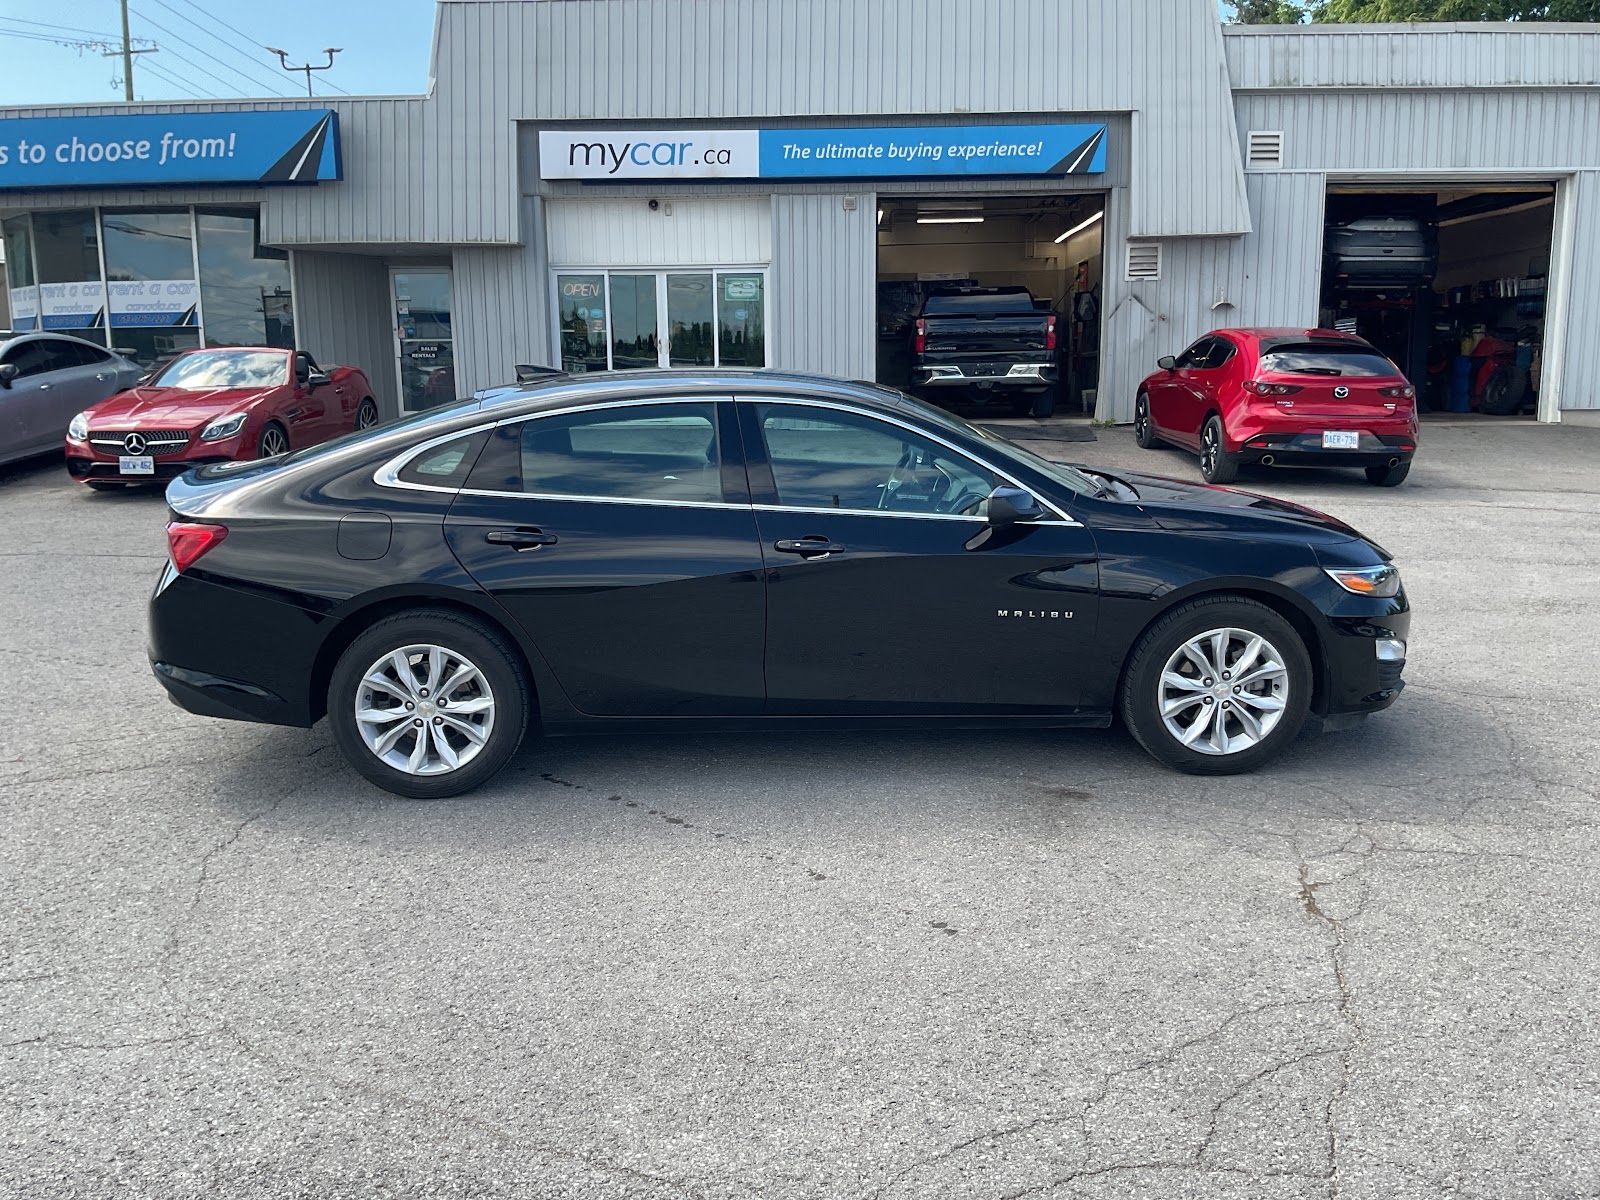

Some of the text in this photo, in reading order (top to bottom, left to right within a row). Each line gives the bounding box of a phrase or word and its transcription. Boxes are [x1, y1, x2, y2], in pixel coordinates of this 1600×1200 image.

[18, 139, 46, 164] to
[55, 136, 151, 162] choose
[159, 132, 236, 165] from!
[782, 141, 1043, 161] The ultimate buying experience!
[569, 142, 731, 174] mycar.ca
[108, 281, 196, 296] rent a car
[563, 283, 600, 297] OPEN
[125, 300, 182, 312] canada.ca
[997, 609, 1074, 619] MALIBU
